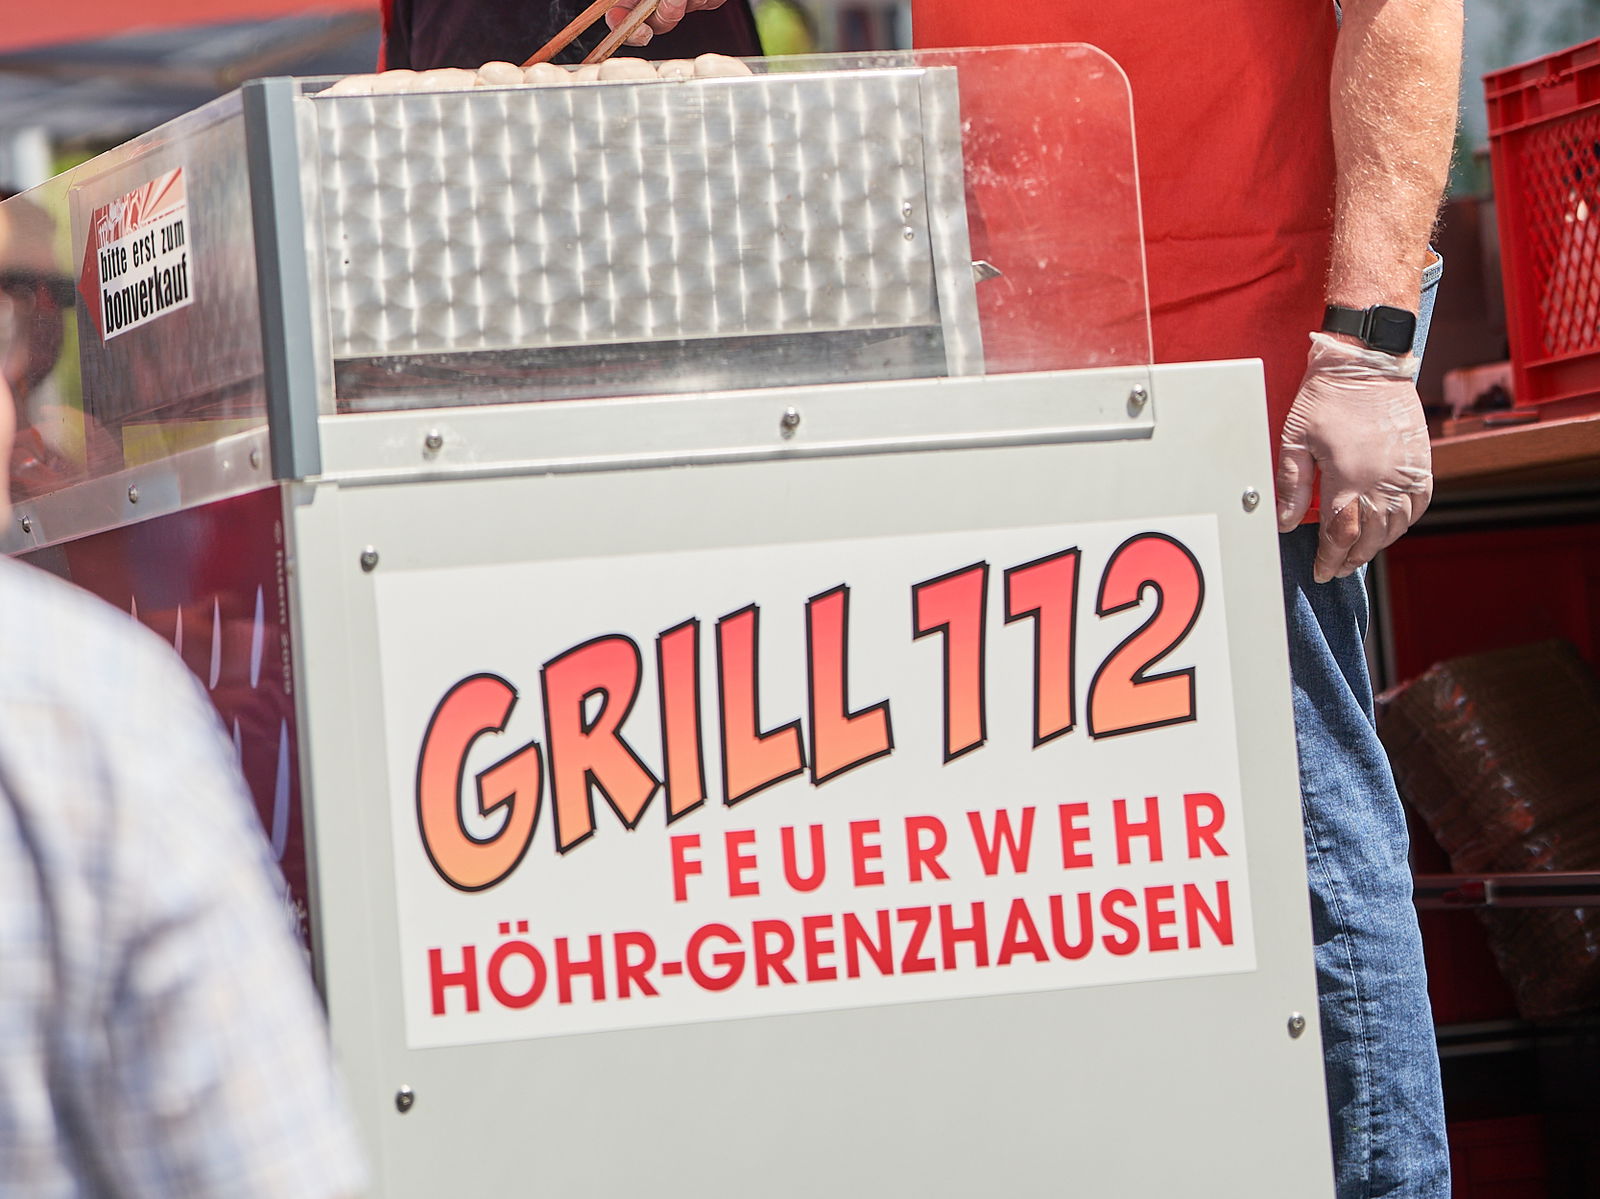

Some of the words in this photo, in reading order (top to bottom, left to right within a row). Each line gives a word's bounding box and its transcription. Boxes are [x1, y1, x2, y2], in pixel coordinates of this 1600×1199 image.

[100, 246, 128, 284] bitte
[133, 229, 156, 268] erst
[161, 219, 185, 255] zum
[103, 252, 189, 335] bonverkauf
[416, 583, 895, 893] GRILL
[911, 531, 1206, 765] 112
[669, 792, 1229, 903] FEUERWEHR
[427, 879, 1234, 1017] HÖHR-GRENZHAUSEN
